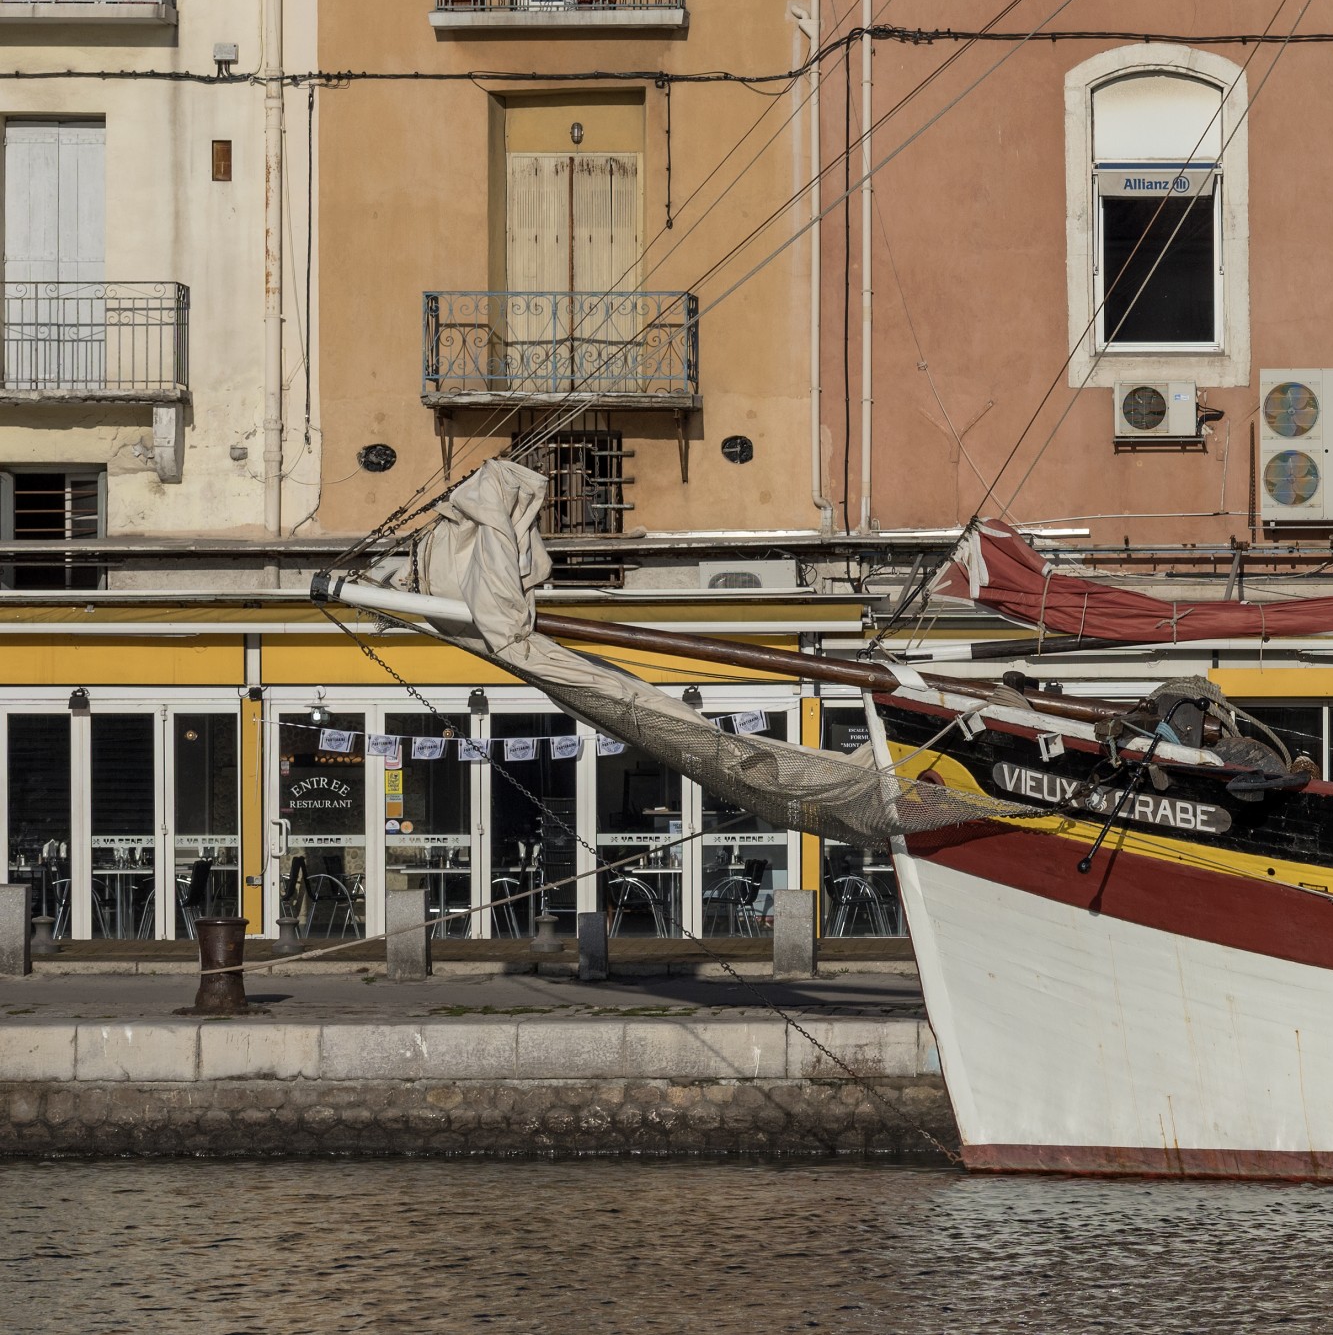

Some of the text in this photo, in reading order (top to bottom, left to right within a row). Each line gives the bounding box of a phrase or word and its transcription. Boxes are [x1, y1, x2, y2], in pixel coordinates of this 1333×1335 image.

[1123, 178, 1169, 190] Allianz
[290, 776, 351, 797] ENTREE
[290, 799, 353, 809] RESTAURANT
[1002, 764, 1216, 832] VIEUX CRABE
